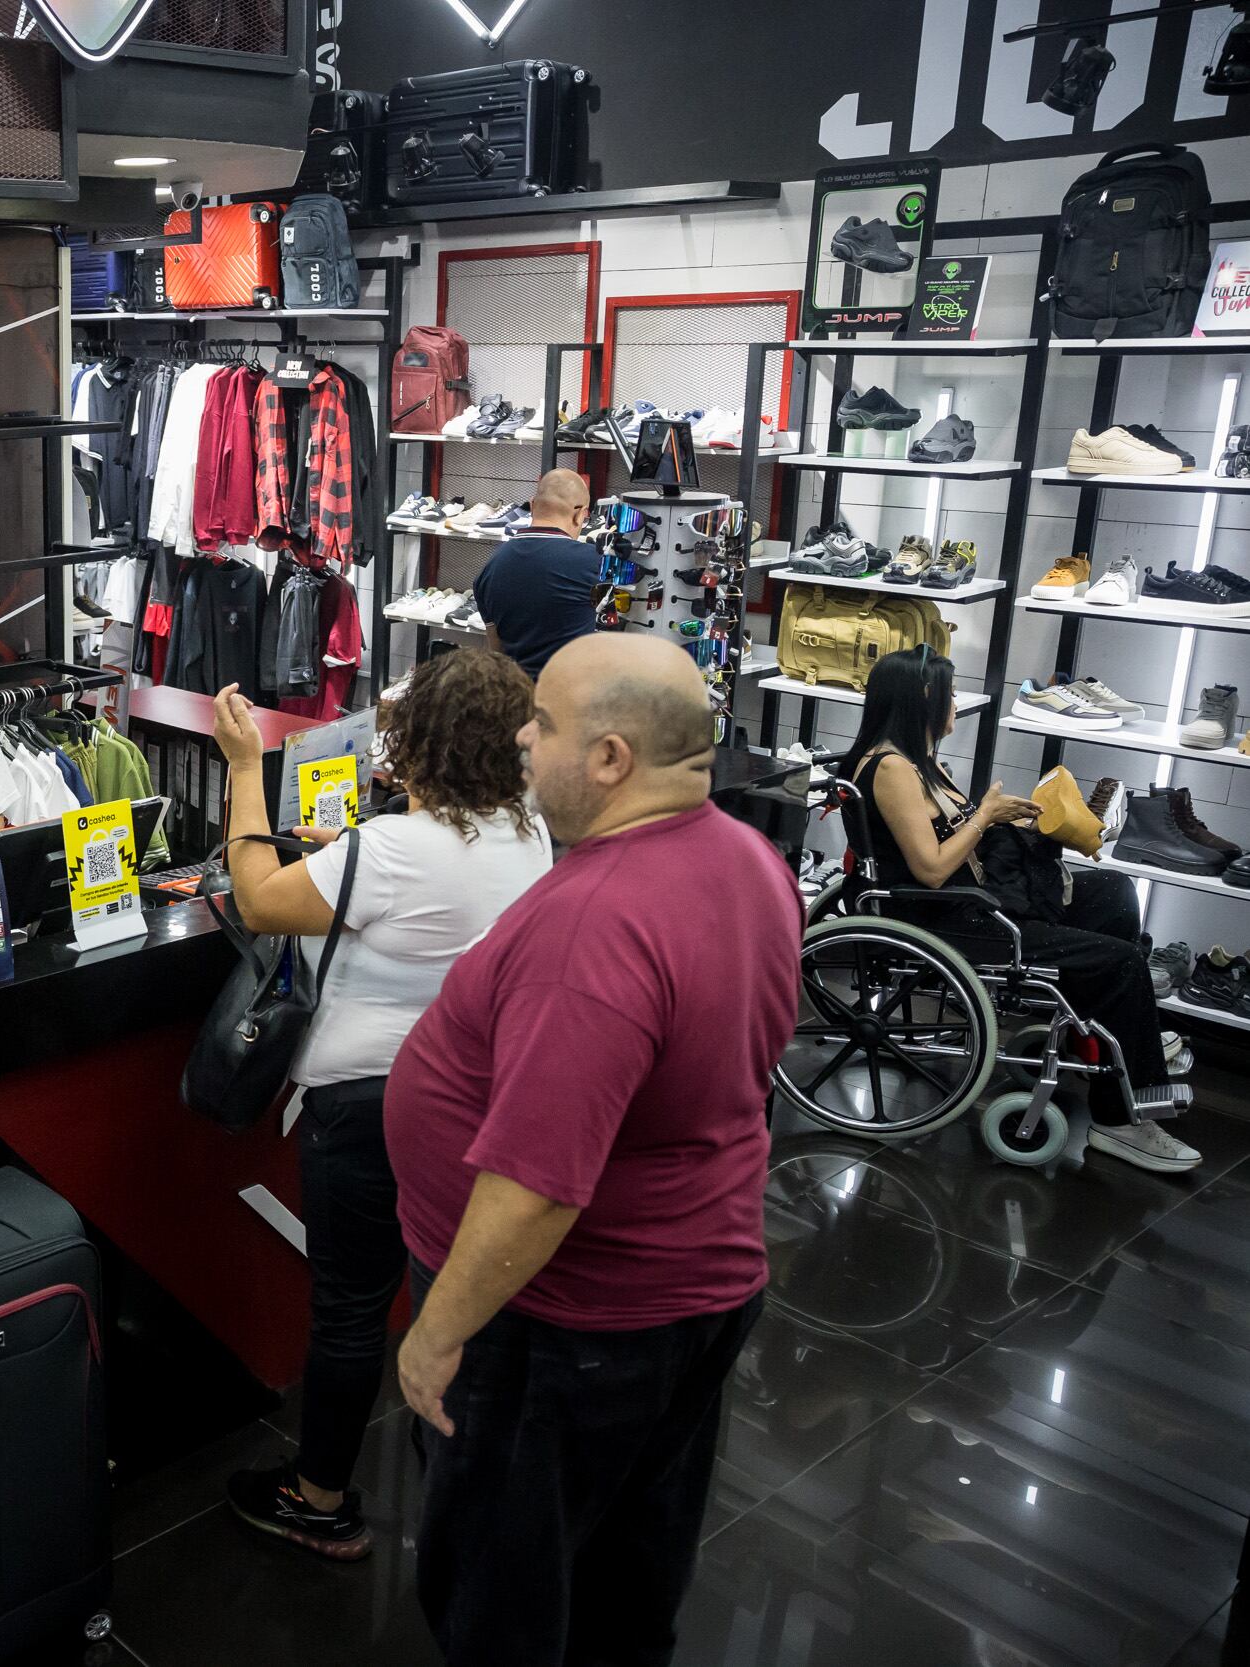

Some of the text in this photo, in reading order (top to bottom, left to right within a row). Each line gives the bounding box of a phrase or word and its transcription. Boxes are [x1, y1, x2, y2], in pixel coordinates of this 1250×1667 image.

[155, 267, 164, 303] COOL
[310, 263, 322, 302] COOL
[922, 303, 960, 311] RETRO
[825, 313, 903, 324] JUMP
[923, 309, 969, 319] VIPER
[320, 768, 344, 778] cashea
[88, 814, 116, 826] cashea
